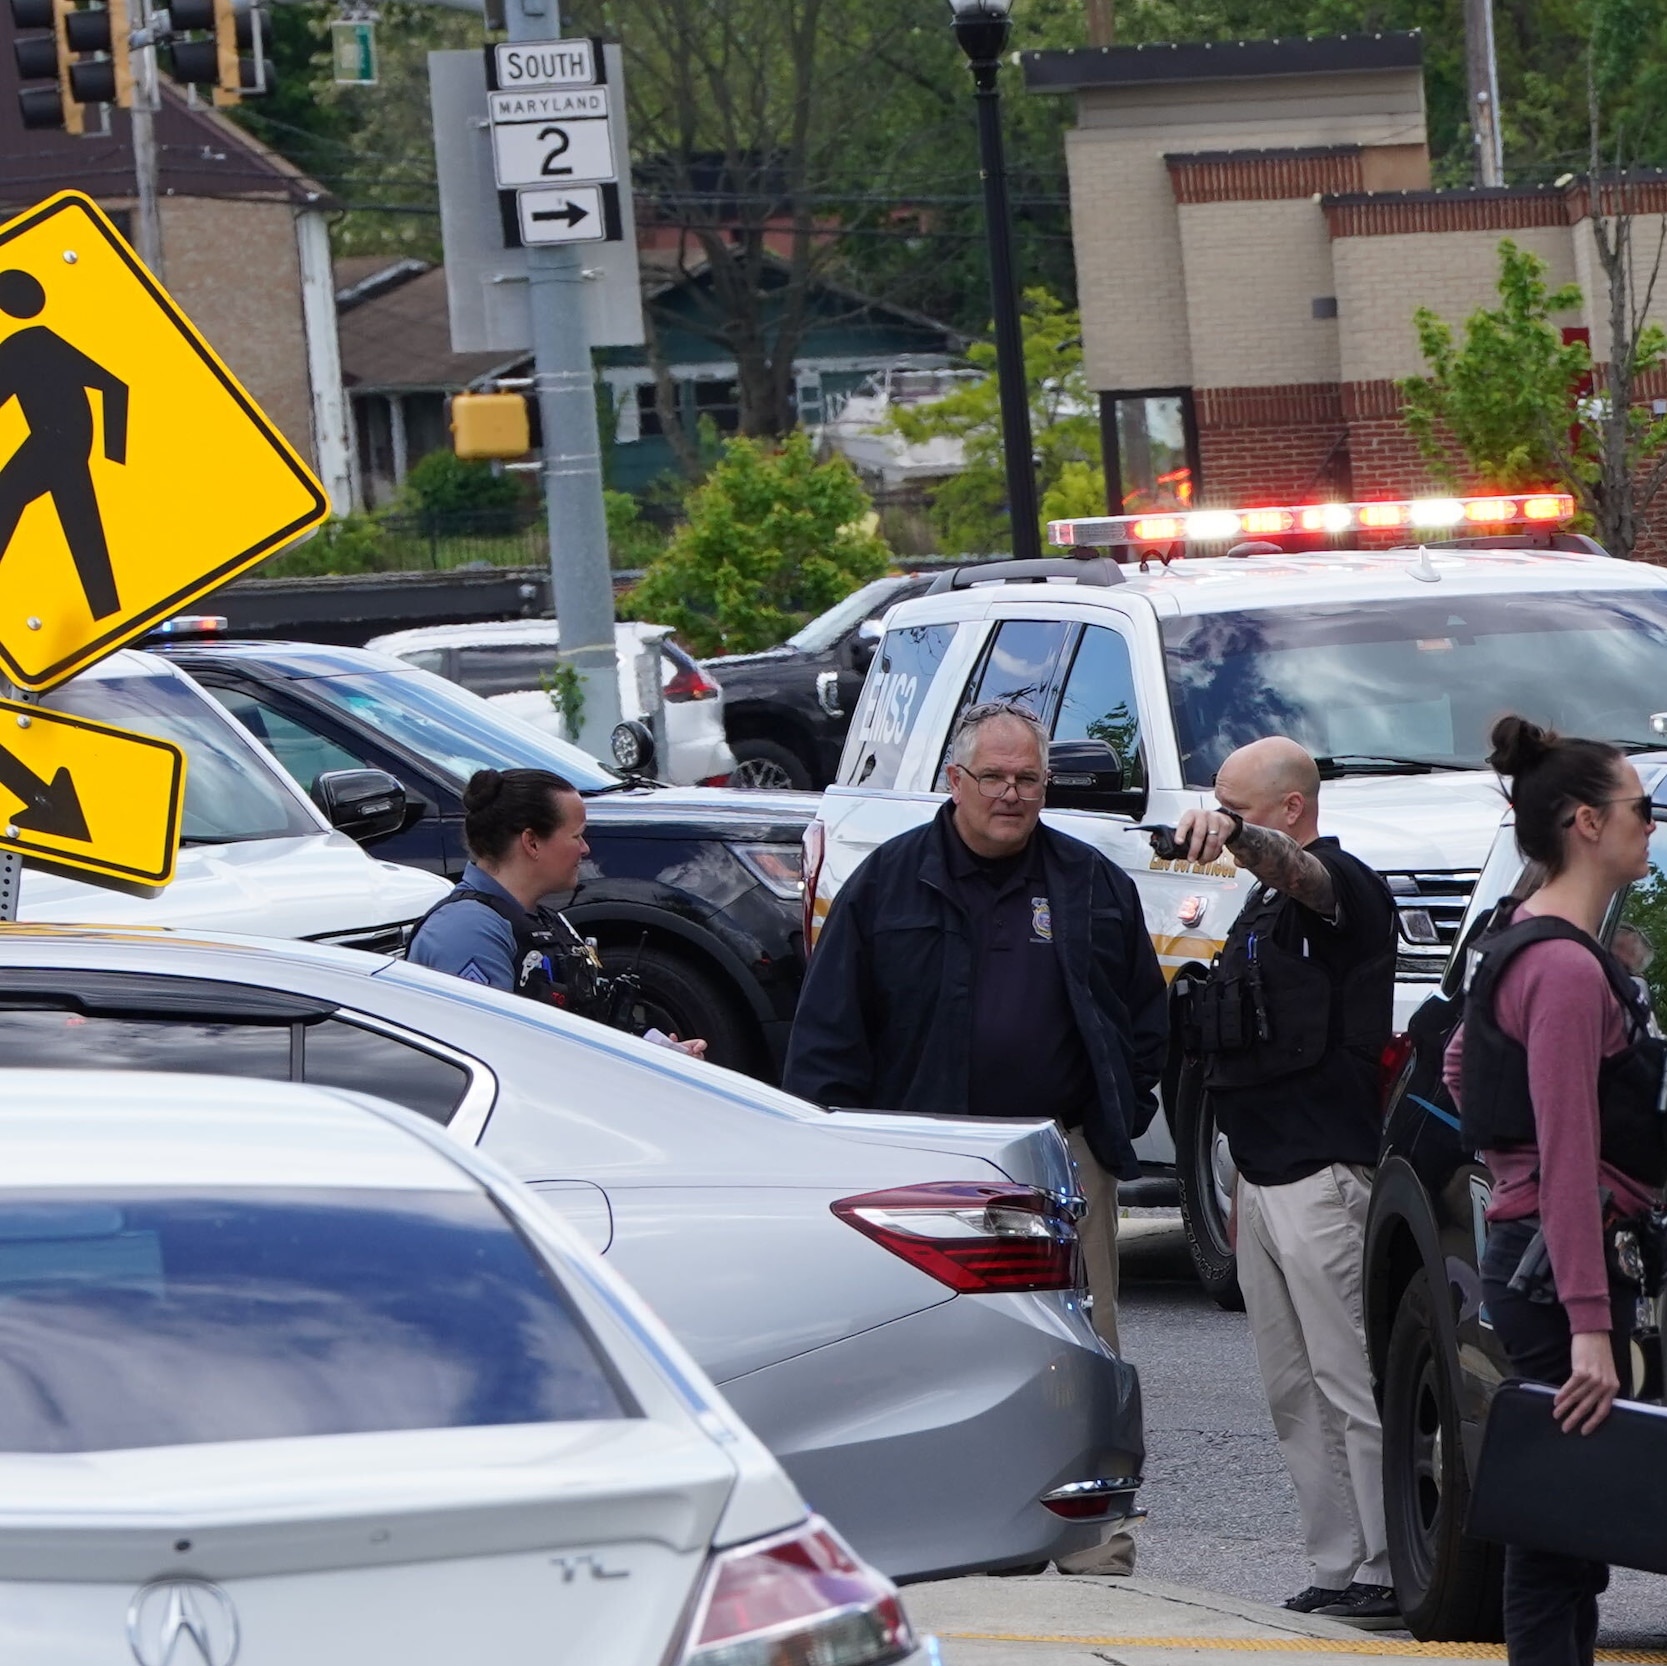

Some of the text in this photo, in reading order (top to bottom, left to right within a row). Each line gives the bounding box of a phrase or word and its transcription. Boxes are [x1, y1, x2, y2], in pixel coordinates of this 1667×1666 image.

[508, 52, 585, 80] SOUTH
[500, 95, 600, 115] MARYLAND
[536, 125, 574, 177] 2
[858, 672, 918, 745] EMS3
